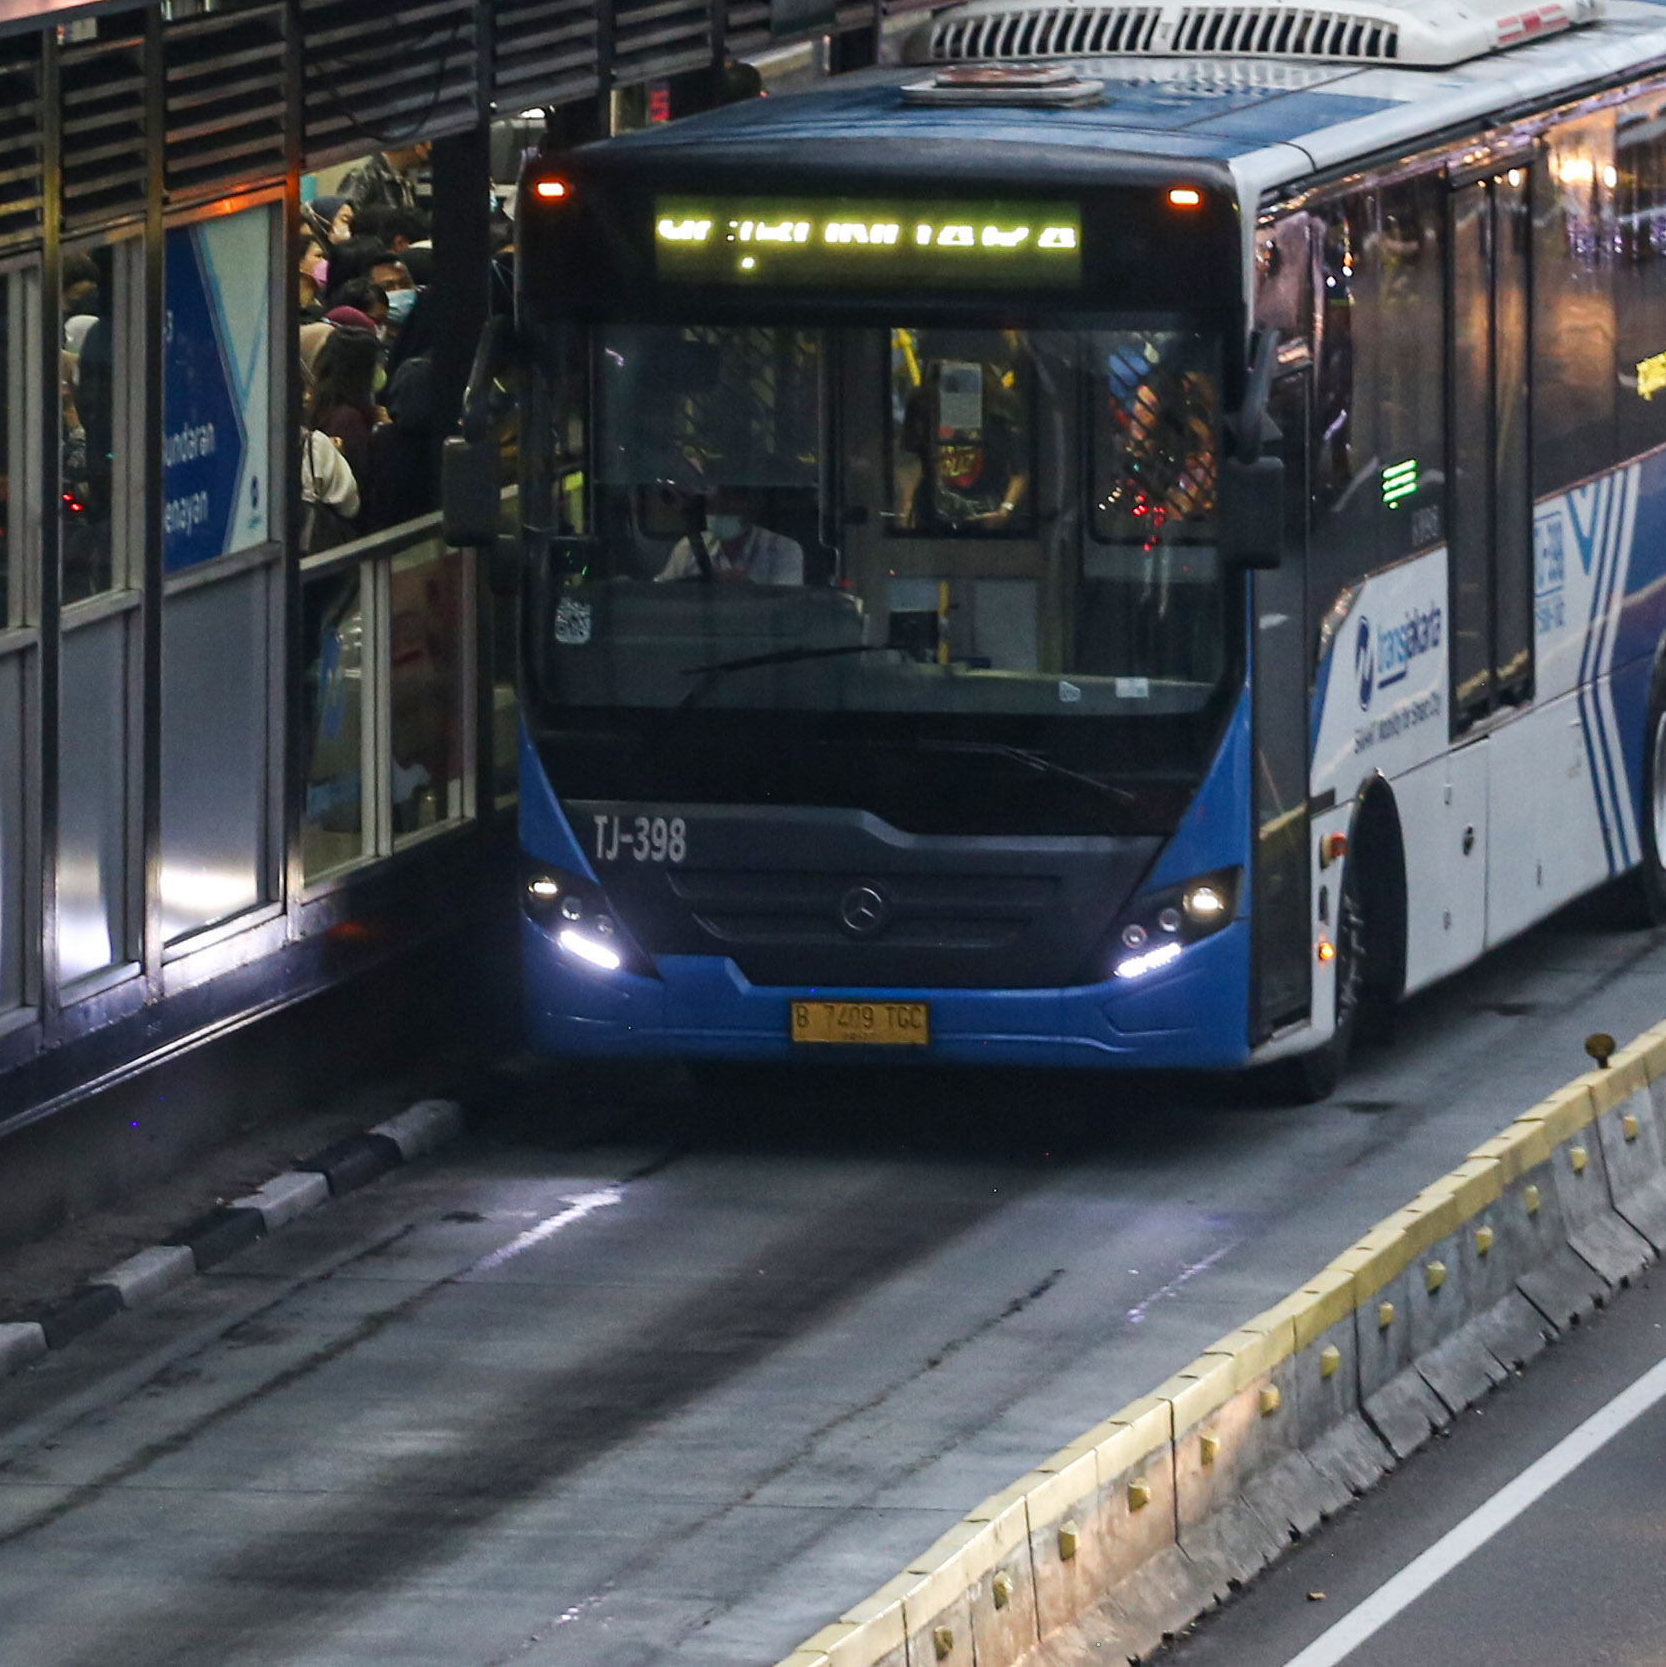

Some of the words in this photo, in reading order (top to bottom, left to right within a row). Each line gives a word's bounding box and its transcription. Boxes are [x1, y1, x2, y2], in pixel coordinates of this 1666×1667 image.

[163, 421, 214, 468] undaran
[164, 489, 209, 537] enayan
[593, 814, 687, 863] TJ-398
[796, 1004, 810, 1028] B
